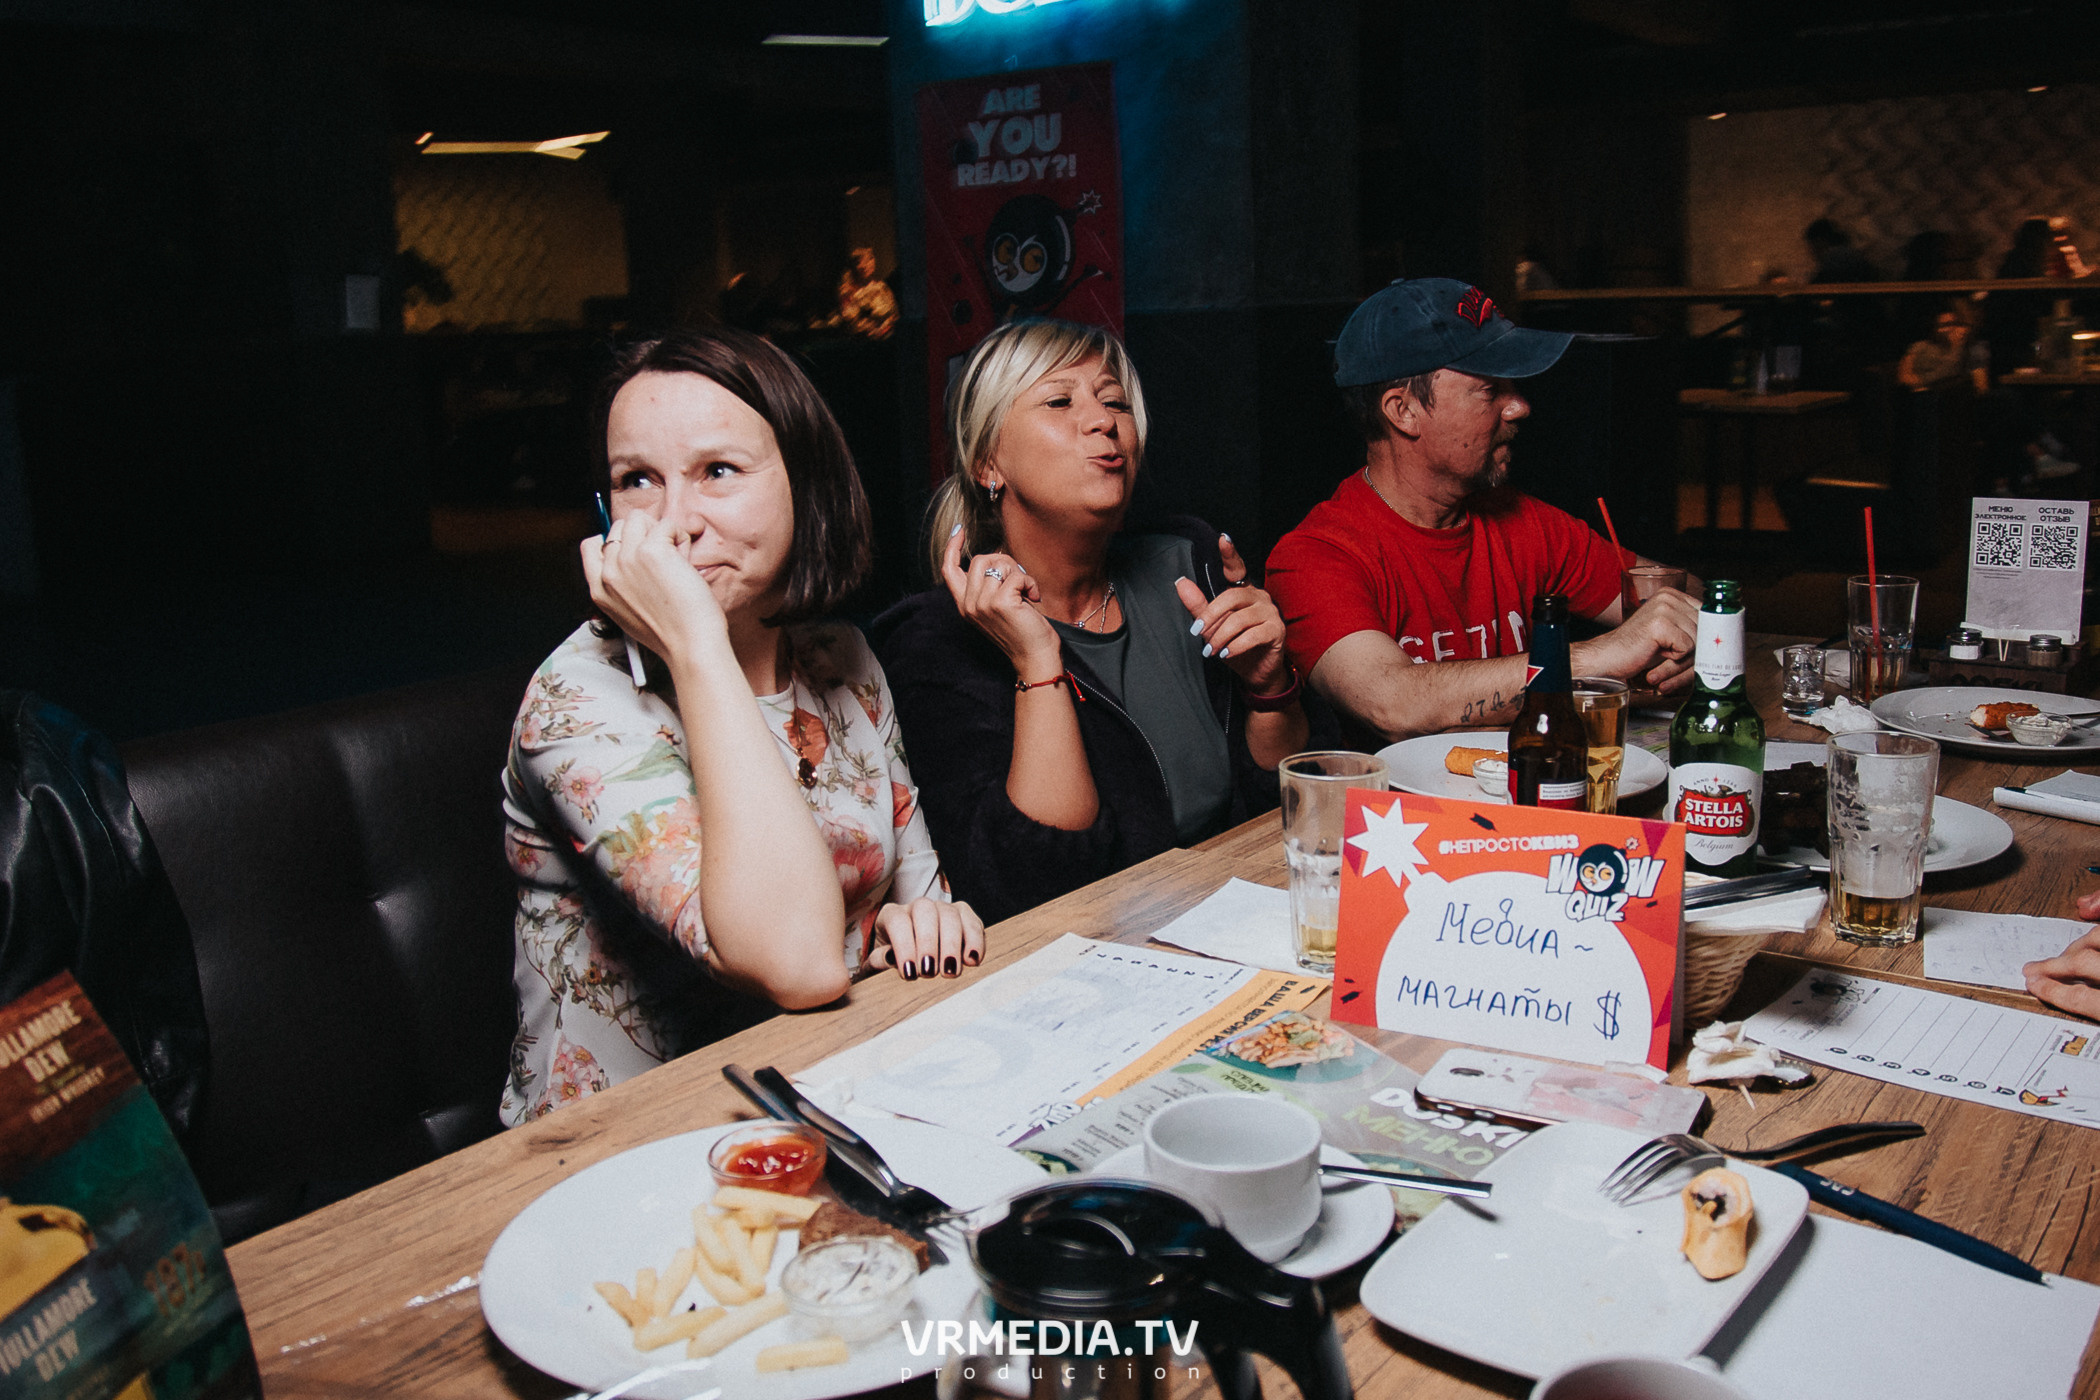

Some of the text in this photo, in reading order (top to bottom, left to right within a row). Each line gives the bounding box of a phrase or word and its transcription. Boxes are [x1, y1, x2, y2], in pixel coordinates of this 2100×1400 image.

[982, 84, 1040, 115] ARE
[968, 113, 1062, 157] YOU
[957, 154, 1077, 187] READY?!
[1974, 513, 2027, 521] ЭЛЕКТРОННОЕ
[2038, 507, 2075, 515] ОСТАВЬ
[2039, 515, 2071, 523] ОТЗЫВ
[1685, 798, 1743, 814] STELLA
[1684, 814, 1744, 829] ARTOIS
[1695, 839, 1734, 851] Belgium
[1564, 891, 1630, 922] QUIZ
[1342, 1104, 1494, 1166] МЕНЮ
